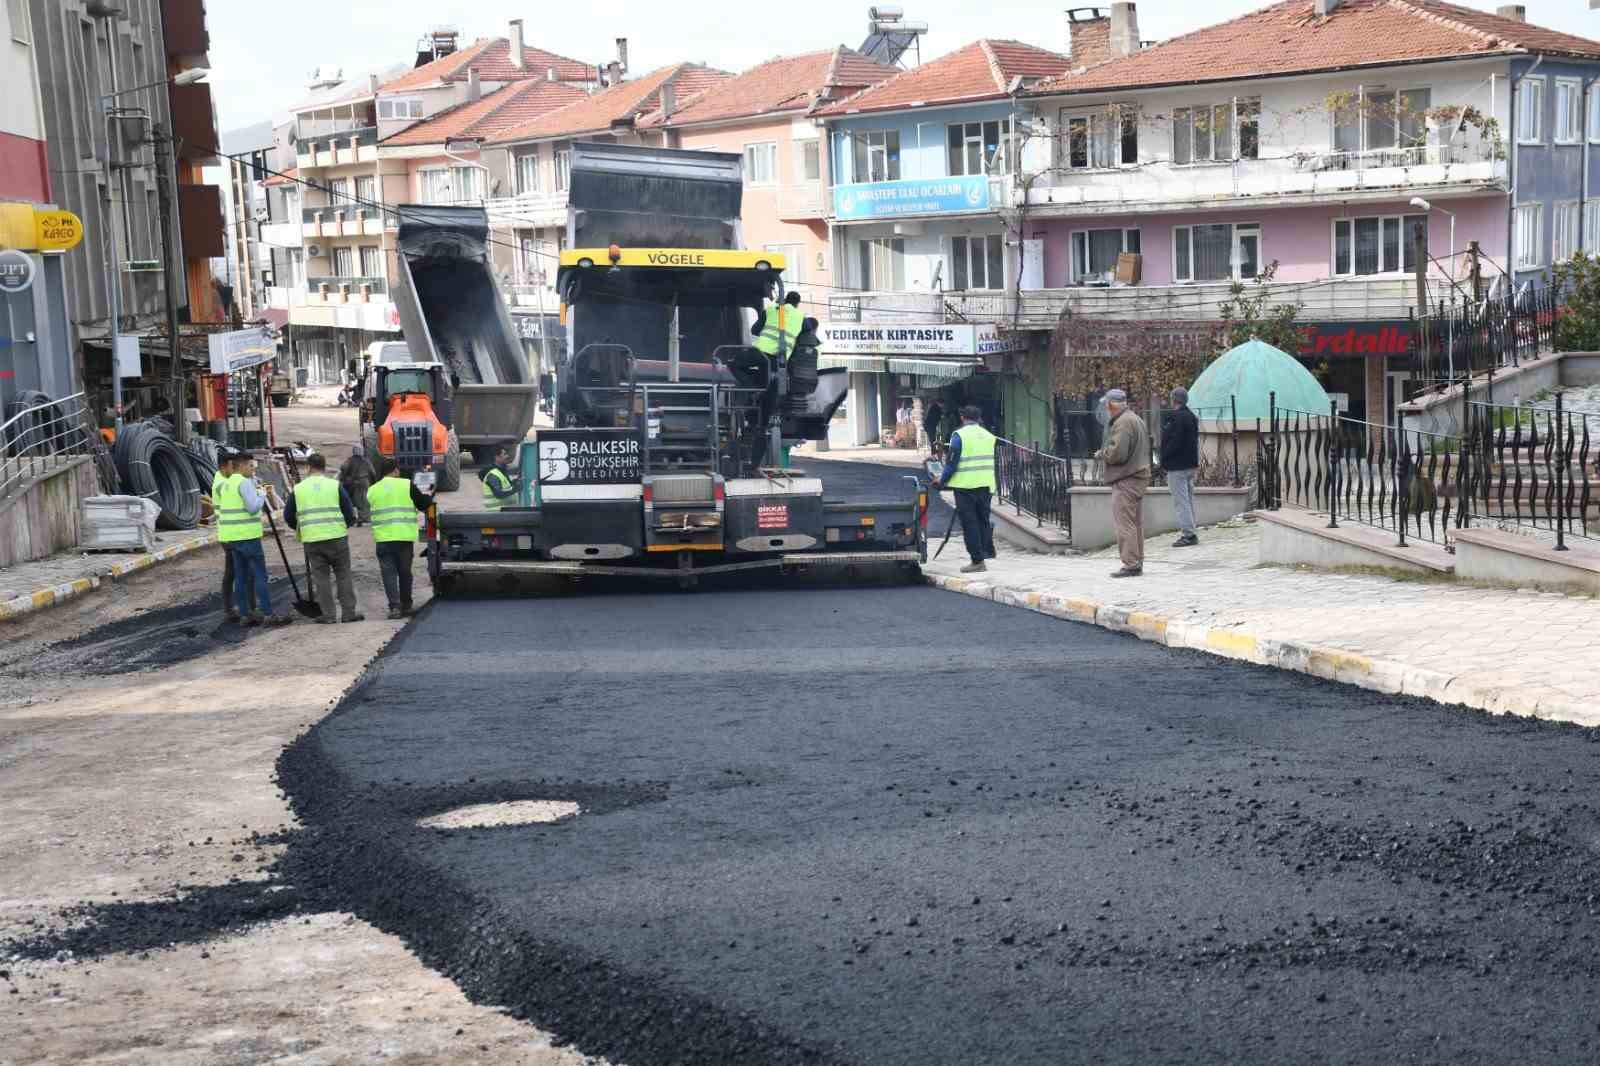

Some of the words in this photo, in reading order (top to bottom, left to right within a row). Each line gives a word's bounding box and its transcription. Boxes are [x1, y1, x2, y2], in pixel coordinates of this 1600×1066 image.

[648, 251, 705, 265] VÖGELE
[887, 327, 954, 341] KIRTASİYE
[570, 438, 639, 454] BALIKESİR
[570, 456, 639, 469] BÜYÜKŞEHİR
[570, 470, 639, 479] BELEDİYESİ
